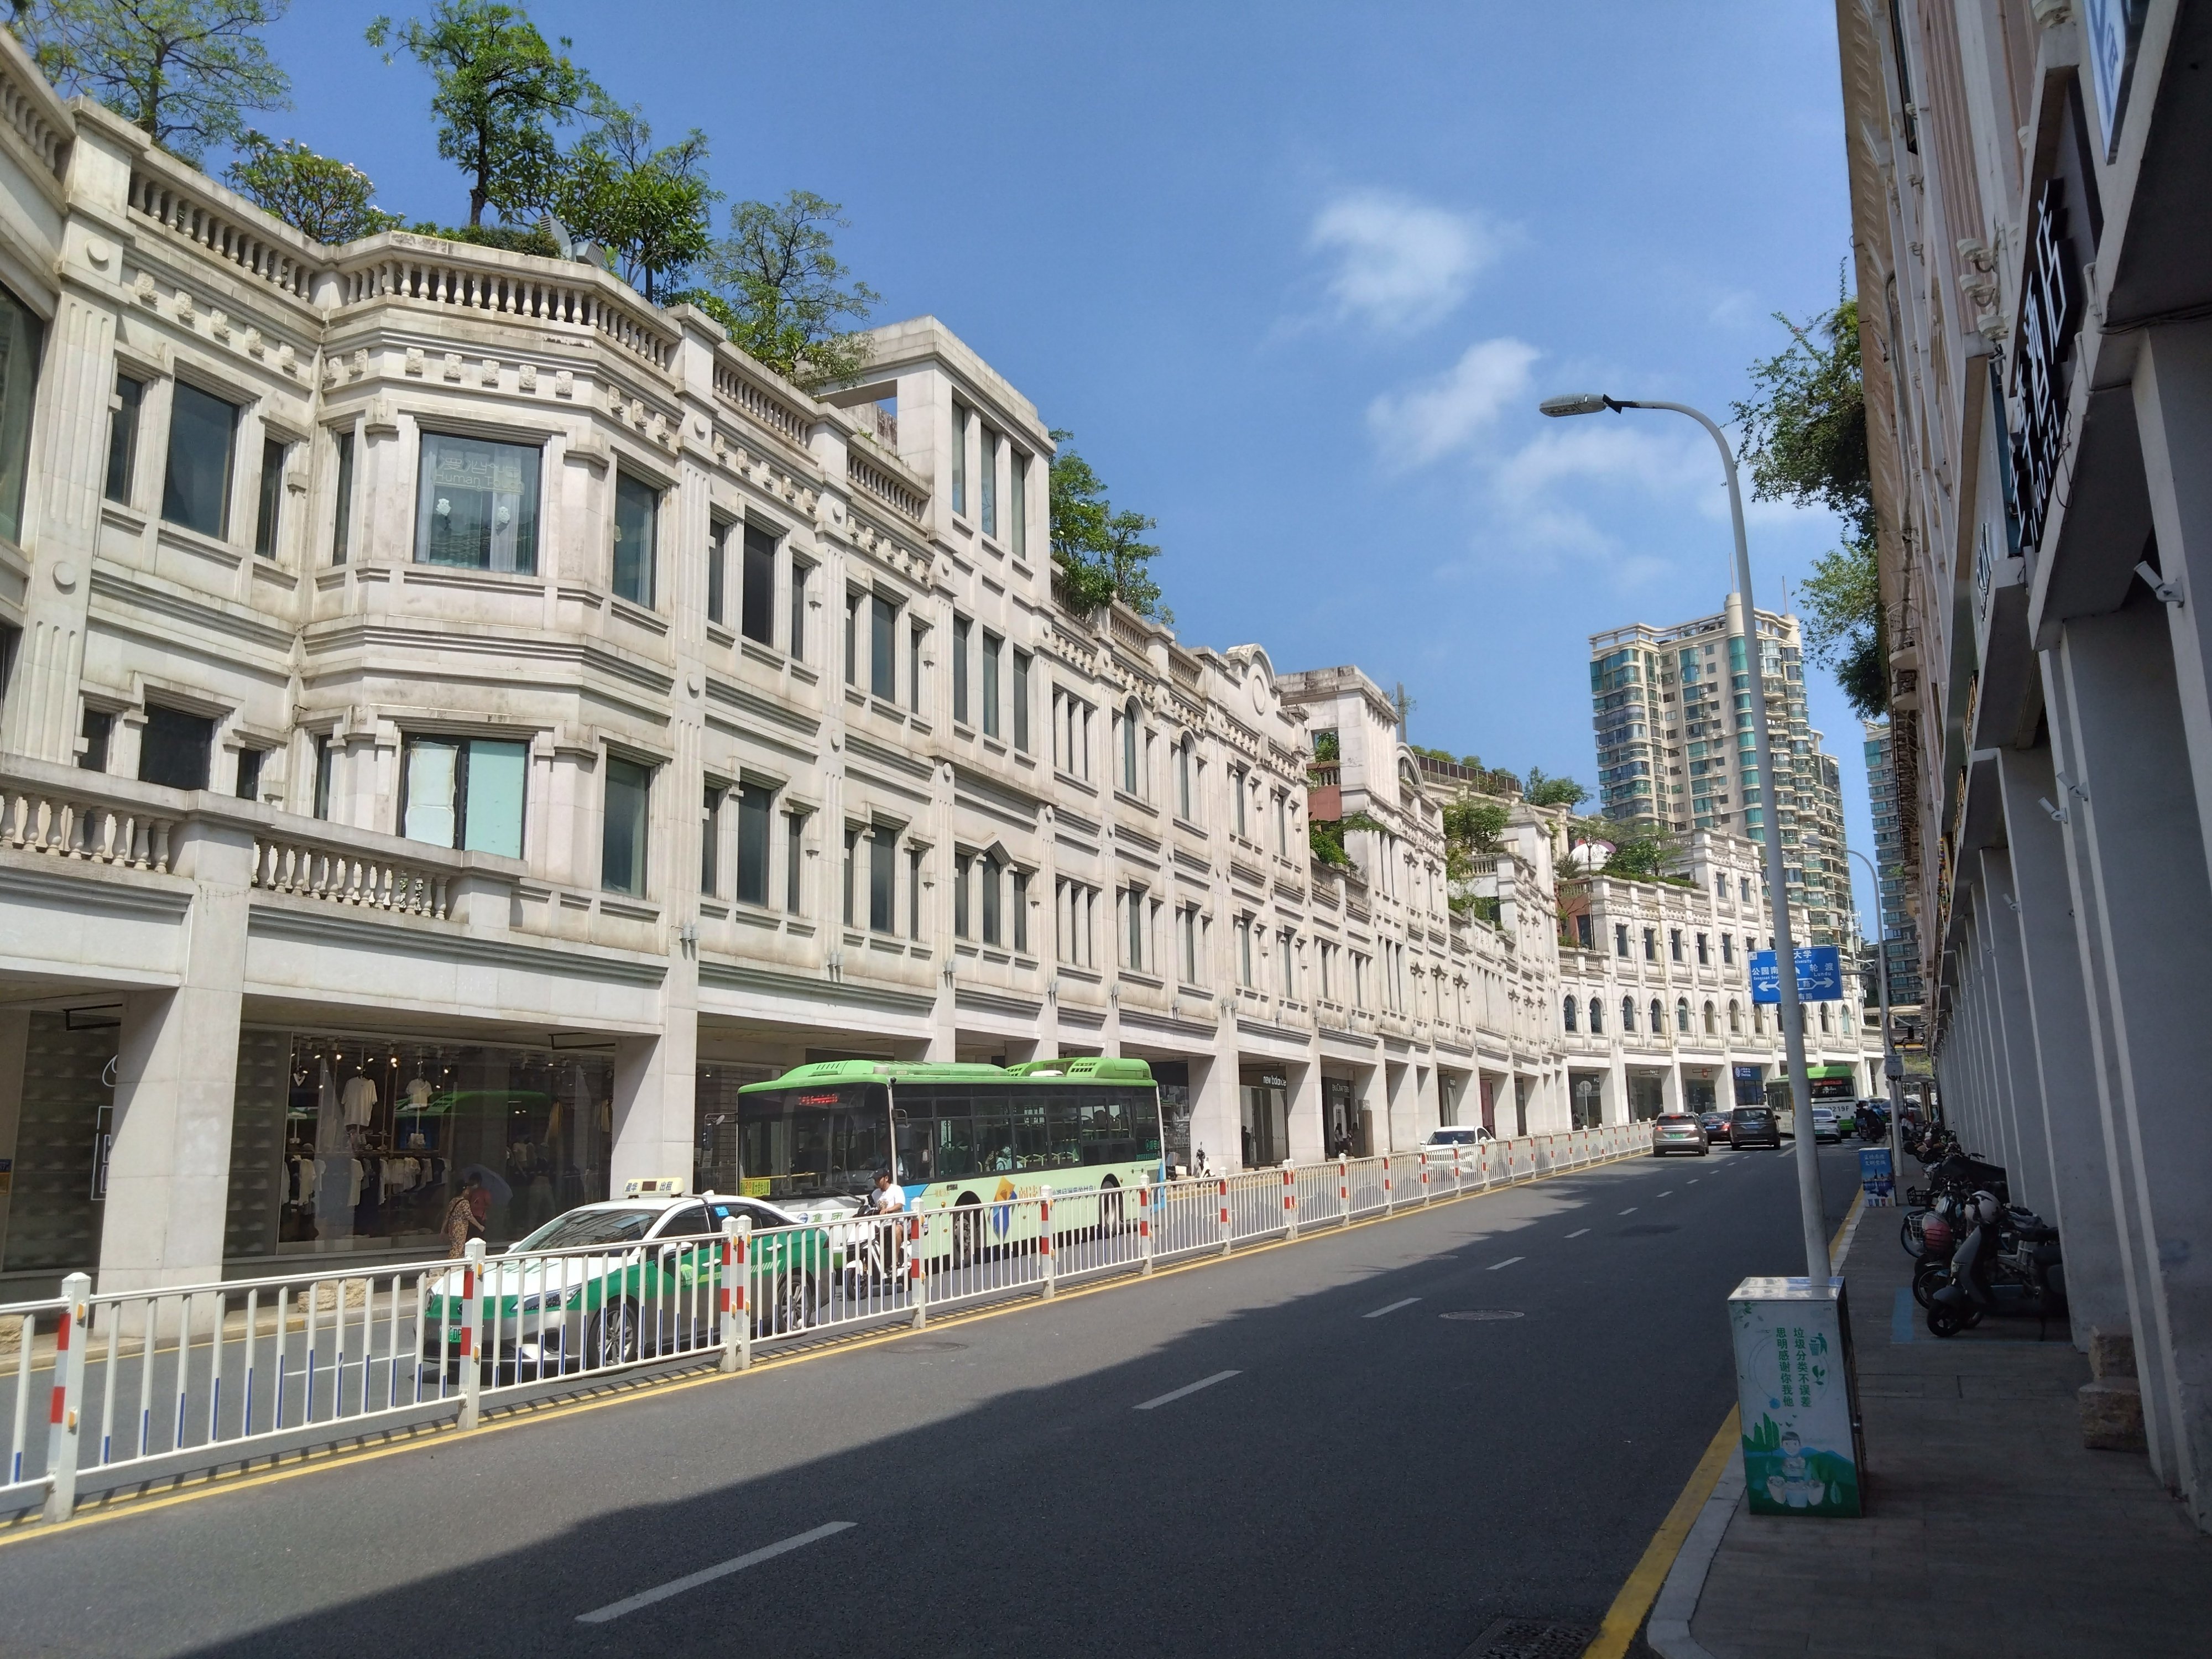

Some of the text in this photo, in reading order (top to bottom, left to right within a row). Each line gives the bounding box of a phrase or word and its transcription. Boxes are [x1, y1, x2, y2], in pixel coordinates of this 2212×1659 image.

[2008, 180, 2067, 550] 全季酒店
[2036, 398, 2061, 523] HOTEL
[1809, 962, 1834, 972] 轮渡
[1271, 1075, 1286, 1086] balance
[659, 1181, 673, 1191] 出租
[811, 1212, 843, 1223] 集团
[1776, 1328, 1794, 1407] 思明感谢你我他
[1793, 1328, 1812, 1407] 垃圾分类不误差
